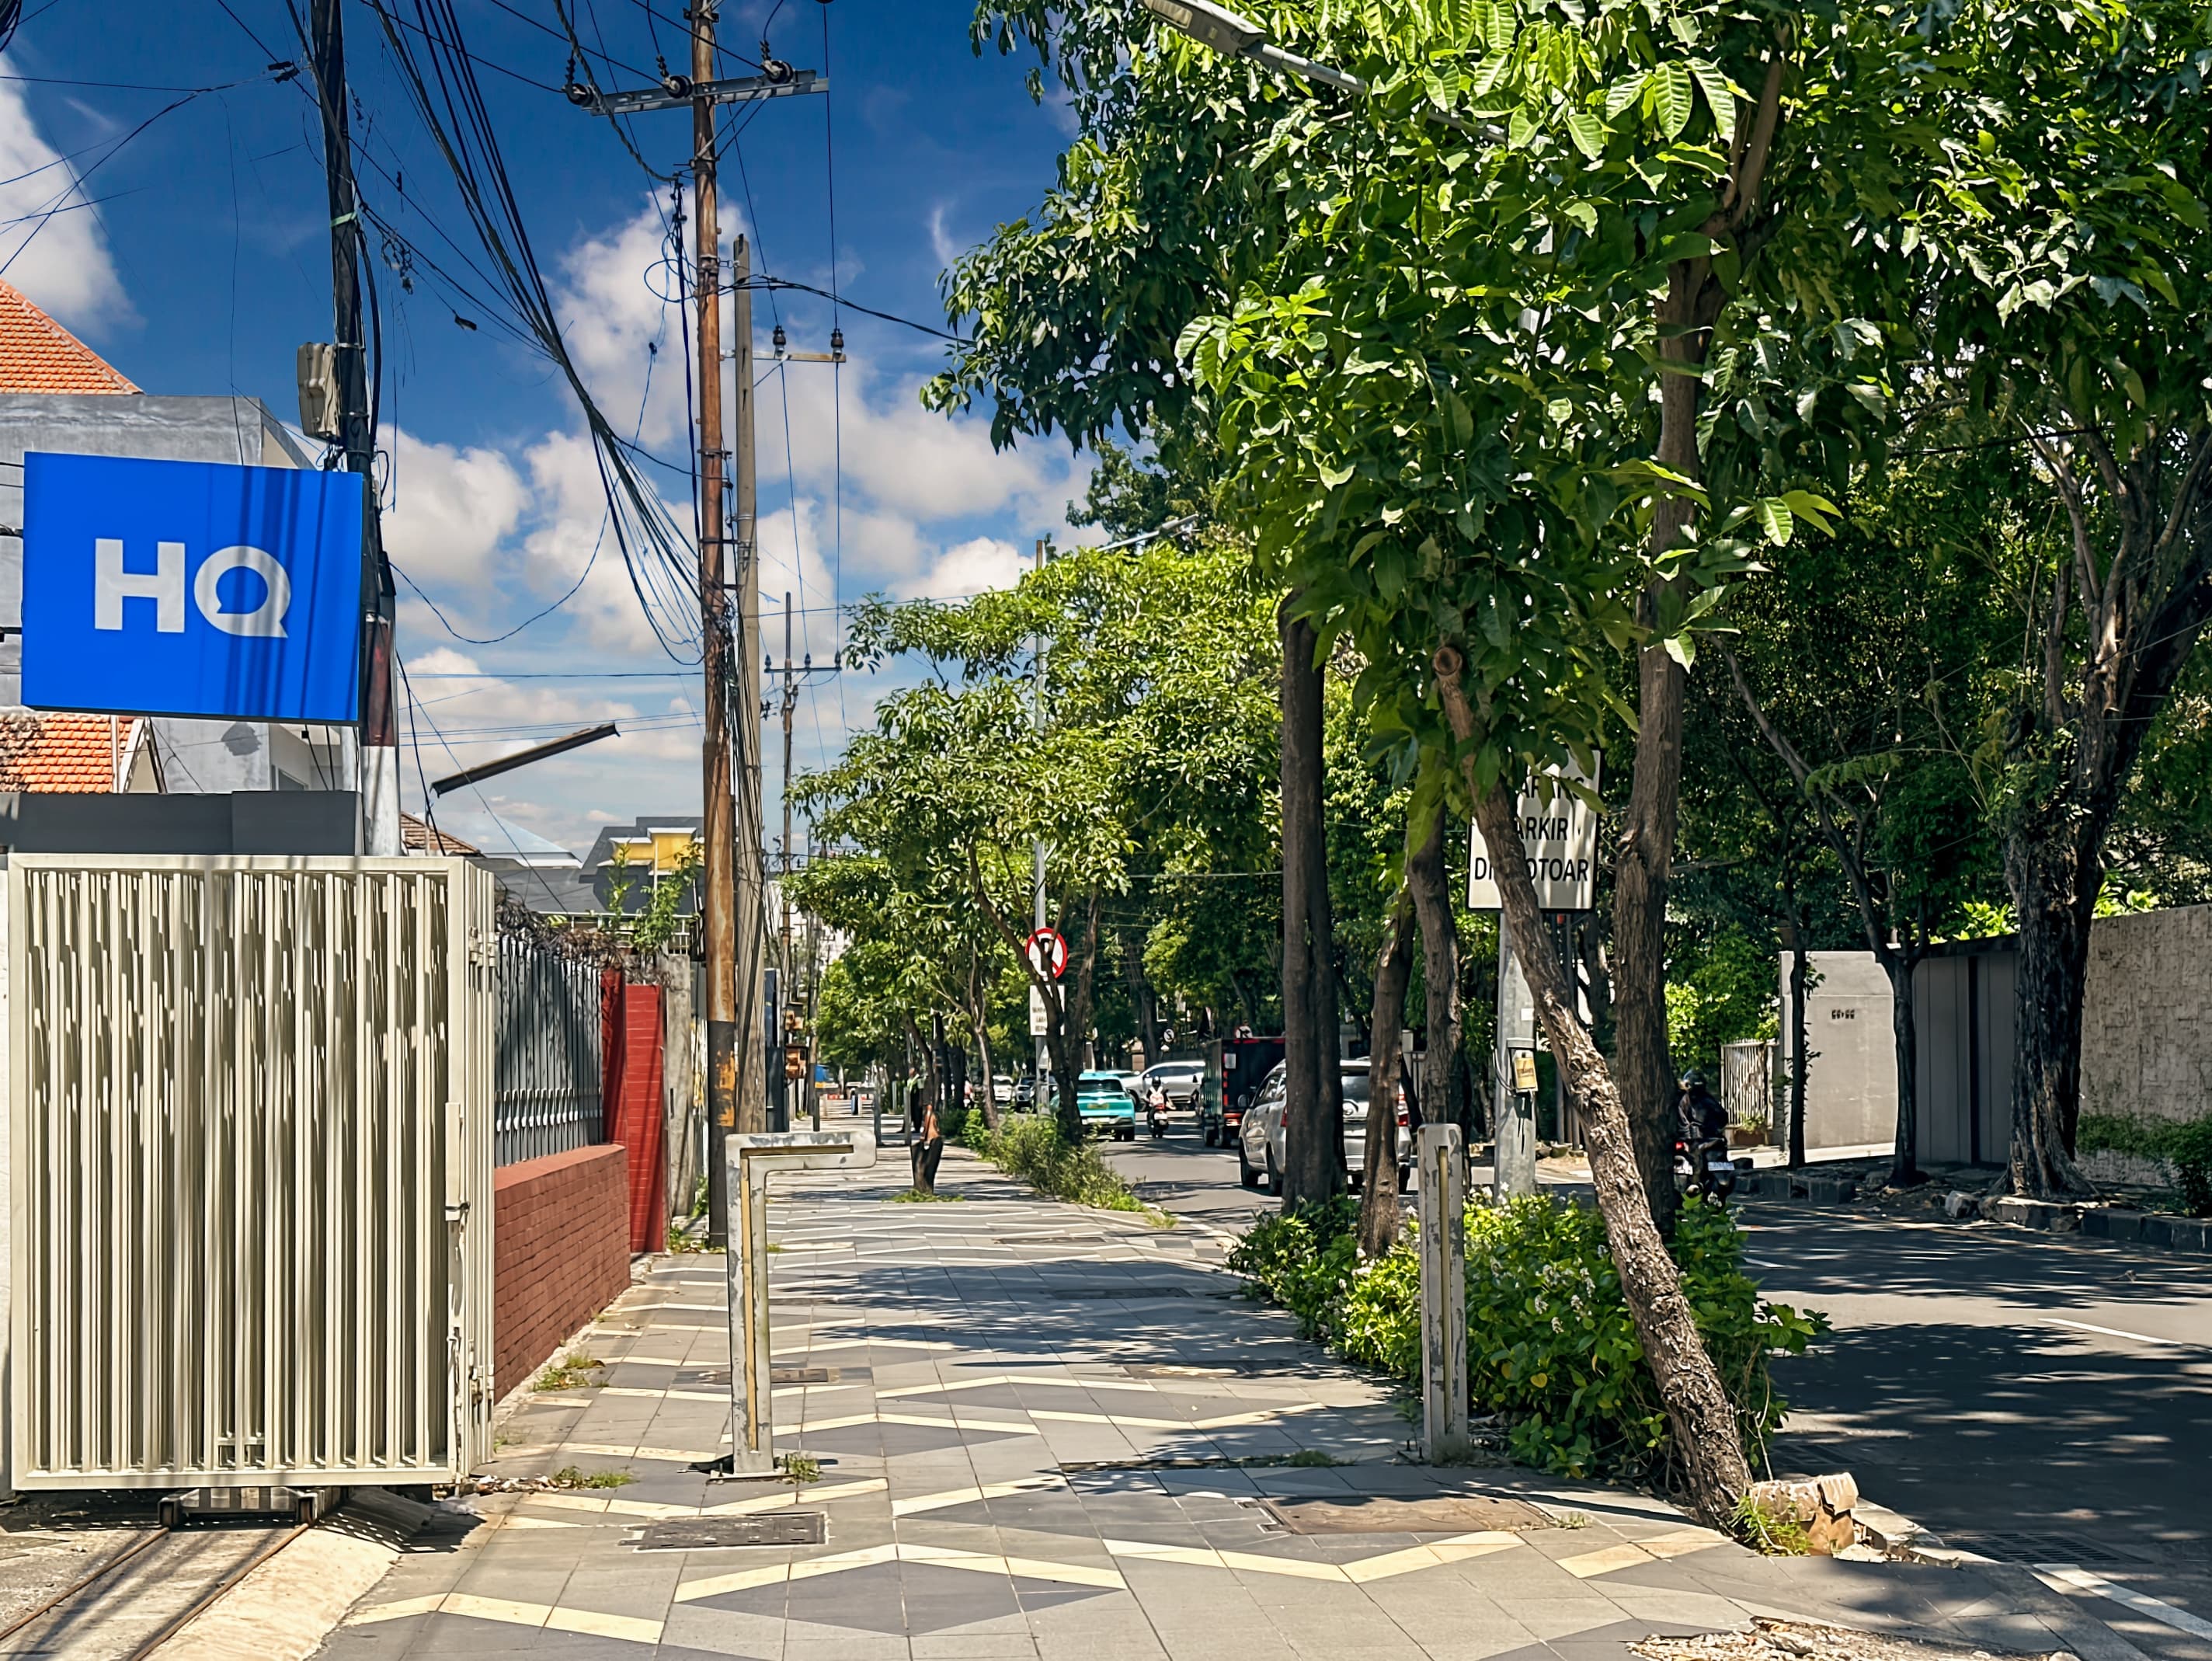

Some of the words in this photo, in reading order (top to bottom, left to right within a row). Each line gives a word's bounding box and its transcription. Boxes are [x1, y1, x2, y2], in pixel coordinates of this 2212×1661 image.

[95, 538, 291, 638] HQ
[1516, 817, 1568, 840] ARKIR
[1525, 858, 1589, 881] OTOAR
